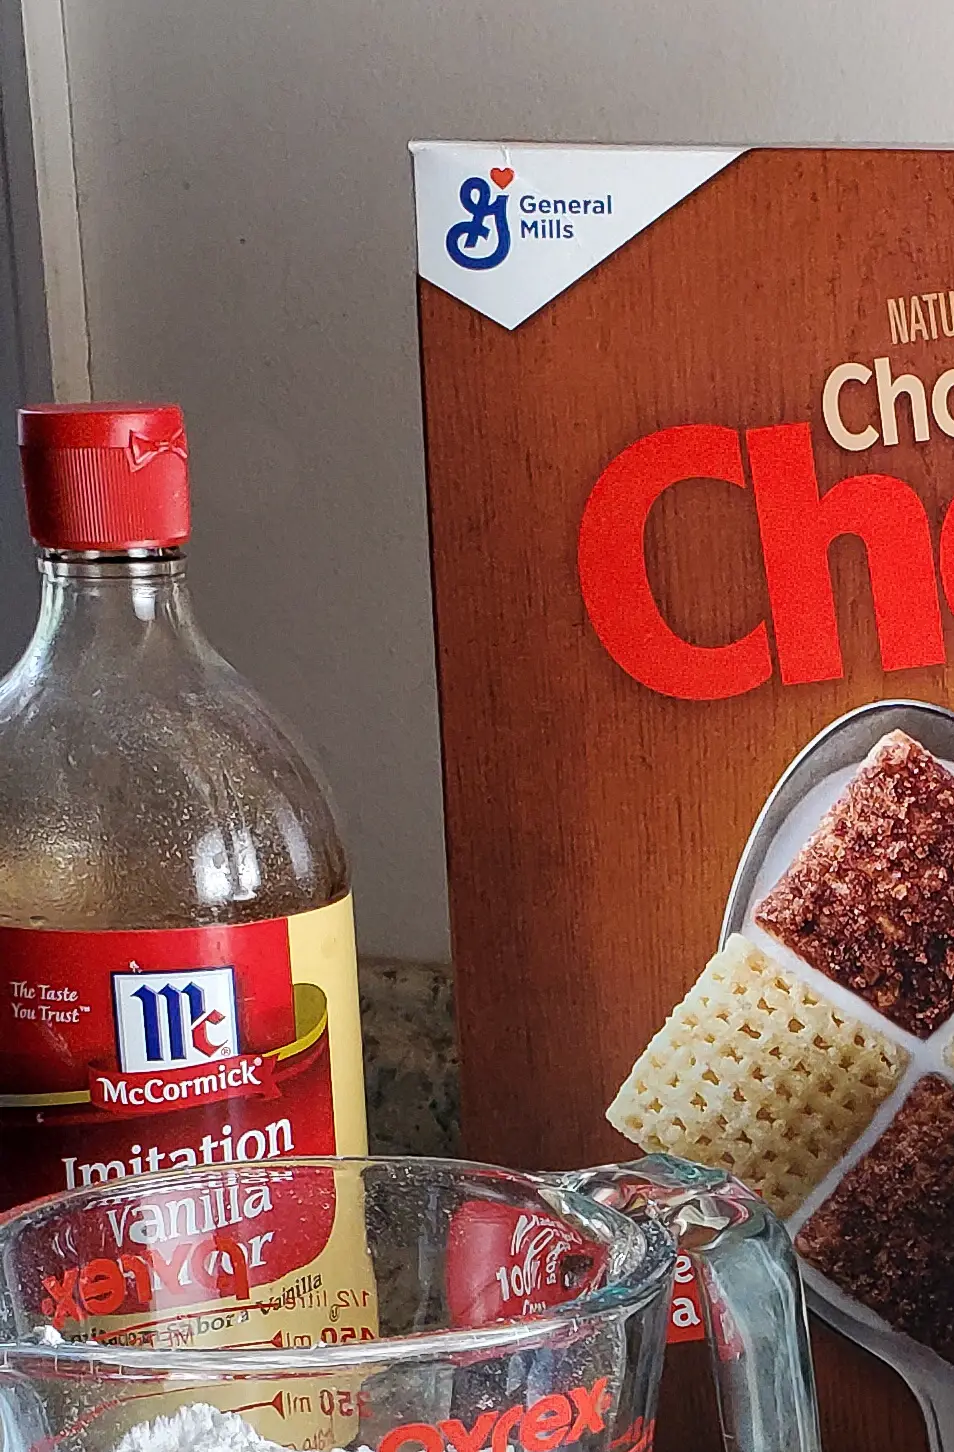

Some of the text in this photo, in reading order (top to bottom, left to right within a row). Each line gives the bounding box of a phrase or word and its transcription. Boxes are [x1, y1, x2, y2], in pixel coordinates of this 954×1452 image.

[519, 195, 613, 215] General
[520, 219, 574, 240] Mills
[10, 981, 79, 1002] The Taste
[11, 1003, 36, 1020] You
[96, 1061, 262, 1106] McCormick
[61, 1118, 295, 1190] Imitation
[106, 1183, 274, 1248] Vanilla
